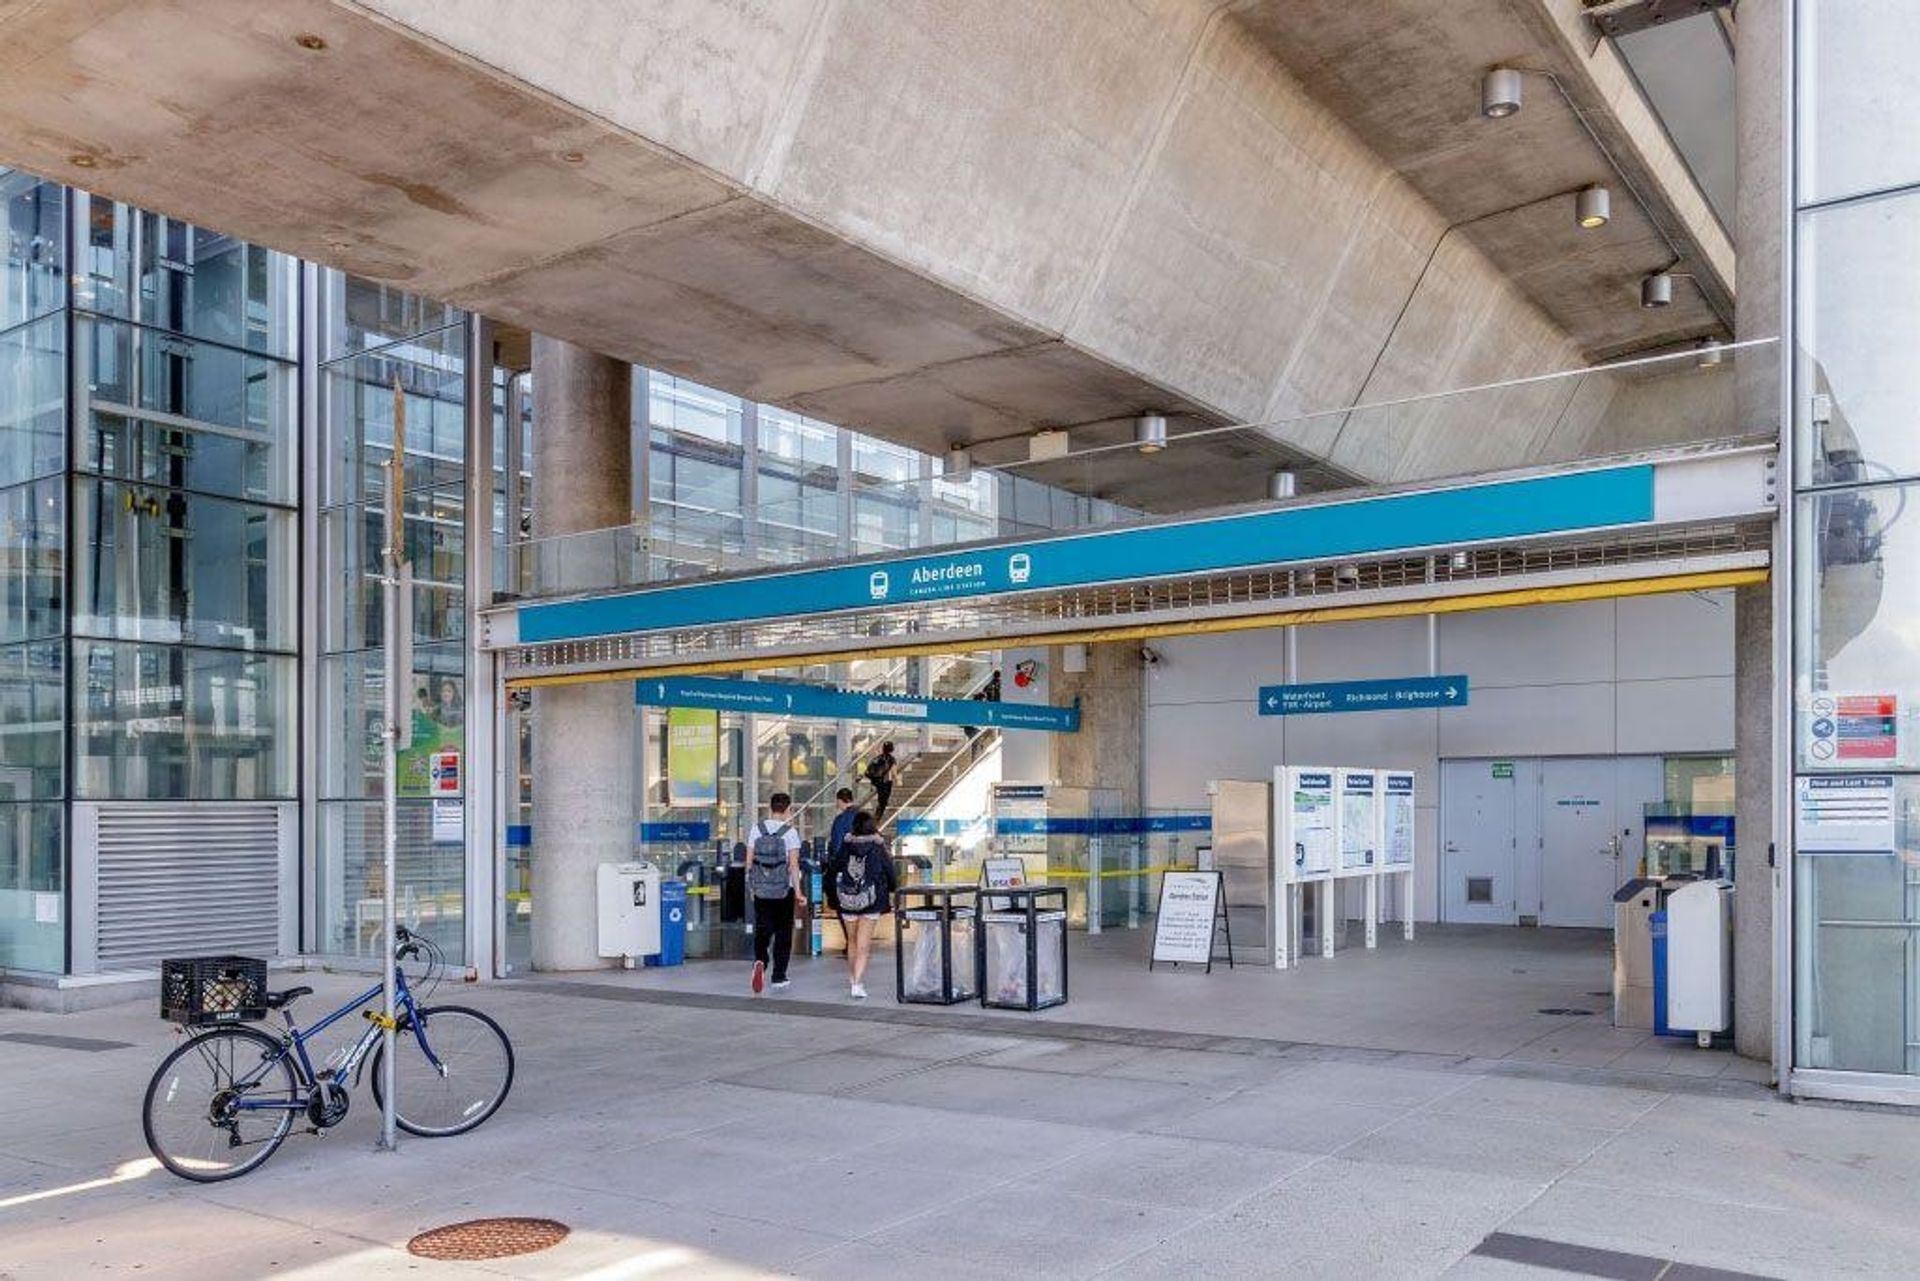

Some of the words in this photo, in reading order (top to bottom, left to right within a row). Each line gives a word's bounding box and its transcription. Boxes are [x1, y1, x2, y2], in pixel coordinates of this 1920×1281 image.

[911, 563, 983, 583] Aberdeen
[1346, 692, 1388, 702] Richmond
[1395, 690, 1440, 702] Brighouse
[1845, 778, 1861, 786] Last
